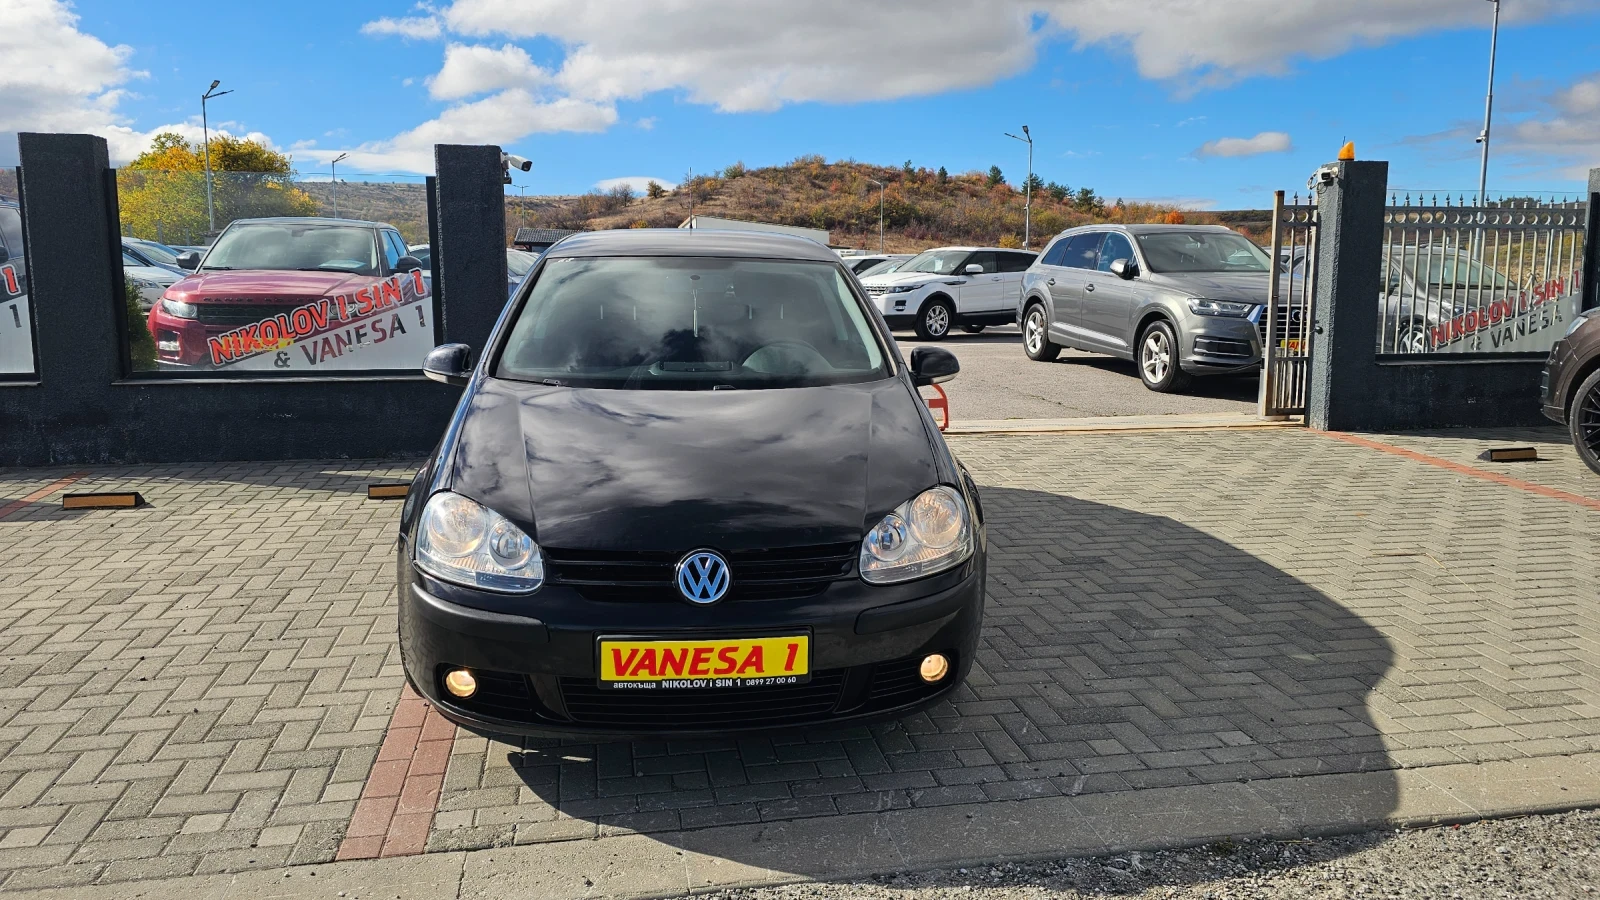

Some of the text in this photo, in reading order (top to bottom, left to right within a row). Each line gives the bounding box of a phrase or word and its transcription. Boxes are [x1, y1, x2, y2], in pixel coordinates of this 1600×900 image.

[2, 266, 20, 294] 1
[9, 303, 22, 328] 1
[209, 300, 330, 365] NIKOLOV
[355, 276, 402, 314] SIN
[411, 269, 426, 295] 1
[1430, 296, 1515, 348] NIKOLOV
[1532, 275, 1565, 307] SIN
[1572, 269, 1580, 289] 1
[1490, 304, 1563, 349] VANESA
[274, 305, 426, 368] & VANESA 1
[678, 552, 730, 604] VW
[611, 643, 798, 677] VANESA 1
[662, 679, 707, 689] NIKOLOV
[715, 678, 733, 687] SIN
[736, 678, 741, 687] 1
